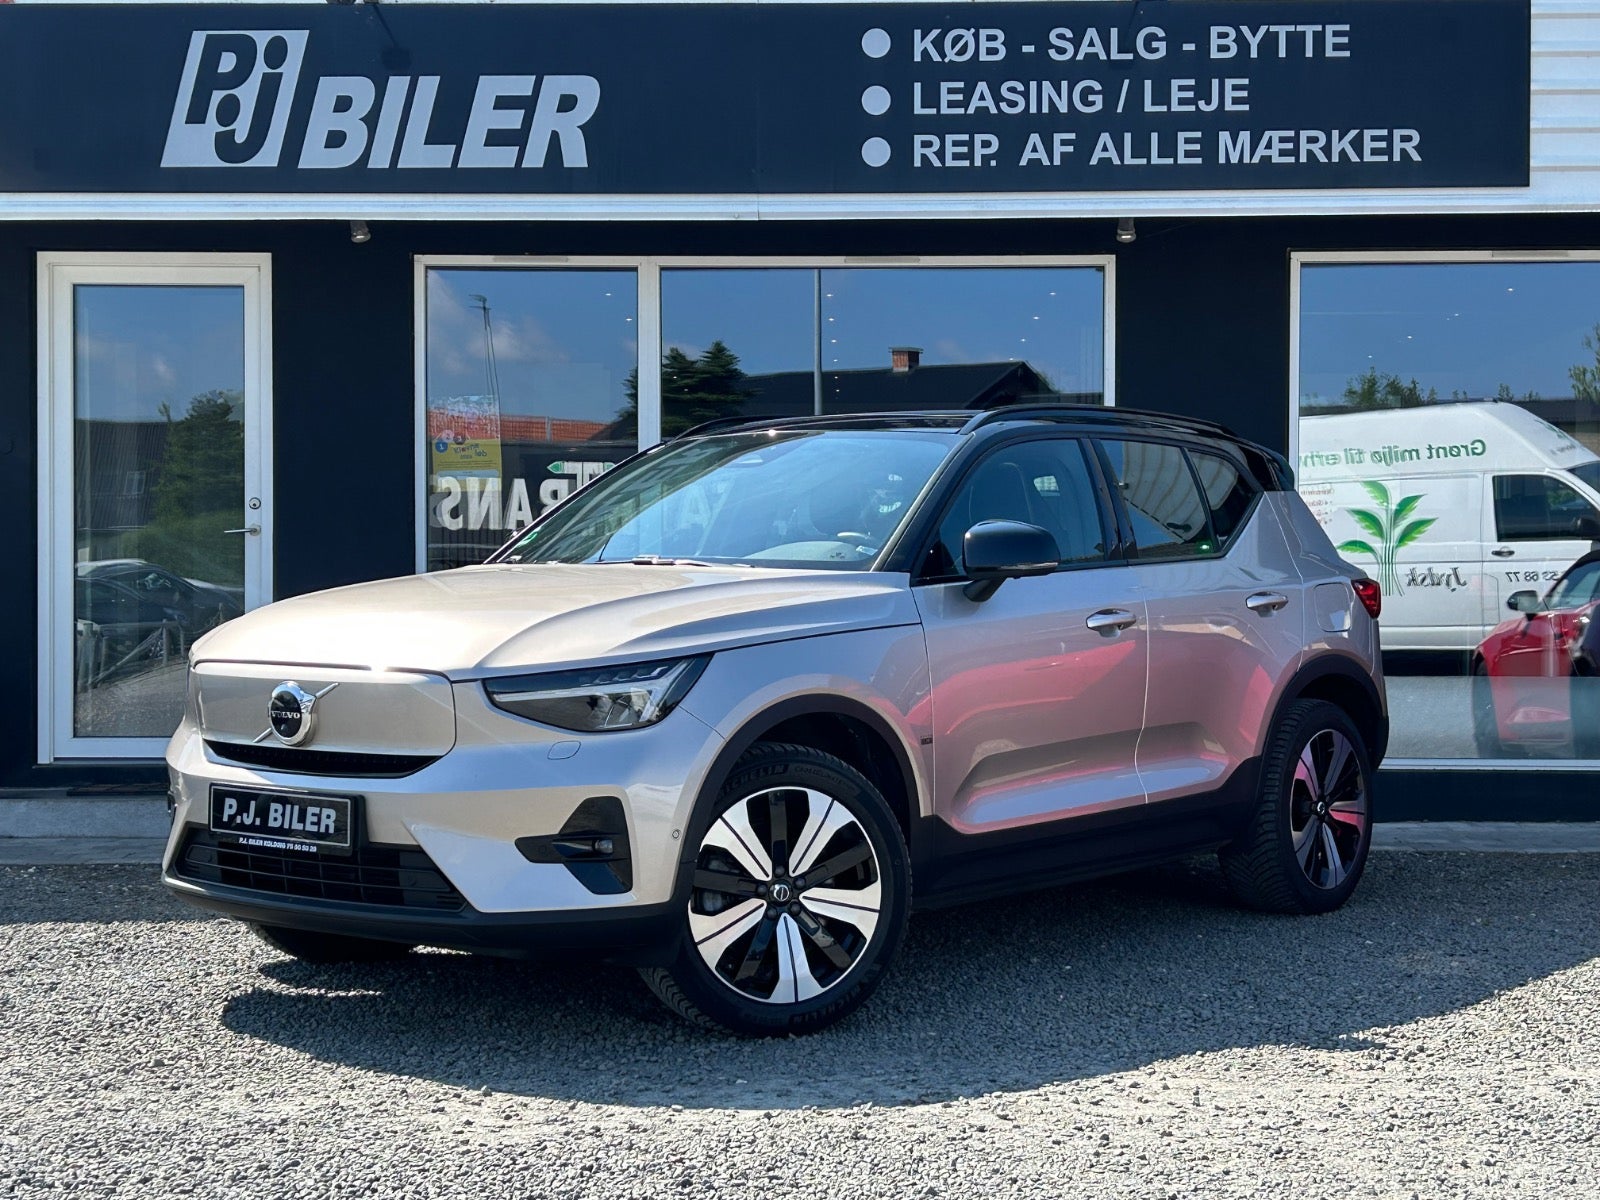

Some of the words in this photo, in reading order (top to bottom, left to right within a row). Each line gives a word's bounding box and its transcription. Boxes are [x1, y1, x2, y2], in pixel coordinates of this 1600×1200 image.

[912, 28, 1007, 64] KØB
[1047, 26, 1168, 62] SALG
[1209, 24, 1351, 60] BYTTE
[913, 80, 1103, 115] LEASING
[1116, 79, 1130, 113] /
[1143, 78, 1250, 112] LEJE
[298, 75, 600, 168] BILER
[912, 134, 998, 167] REP.
[1019, 133, 1076, 166] AF
[1089, 131, 1202, 166] ALLE
[1218, 128, 1422, 164] MÆRKER
[271, 711, 301, 719] VOLVO
[222, 797, 261, 826] P.J.
[268, 803, 337, 834] BILER
